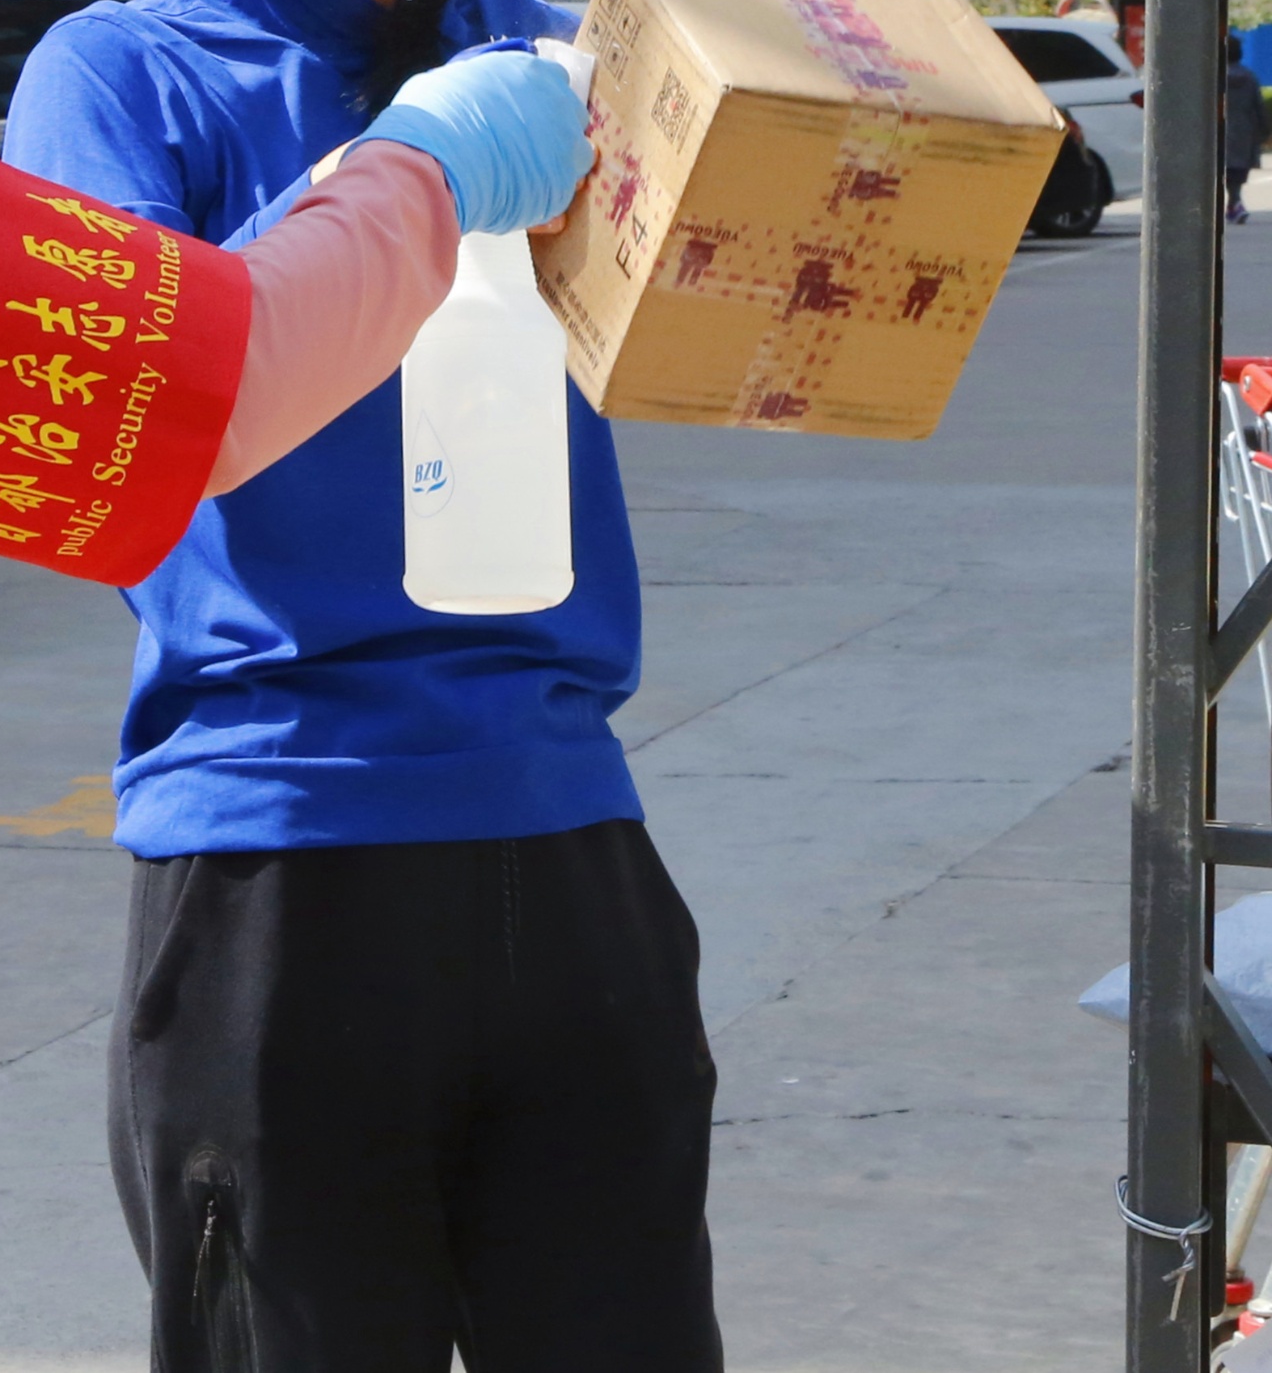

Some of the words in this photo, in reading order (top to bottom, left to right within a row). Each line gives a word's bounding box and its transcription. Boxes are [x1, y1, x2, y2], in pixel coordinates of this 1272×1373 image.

[57, 500, 113, 557] public
[93, 363, 167, 486] Security
[136, 230, 182, 344] Volunteer
[413, 457, 446, 485] BZQ
